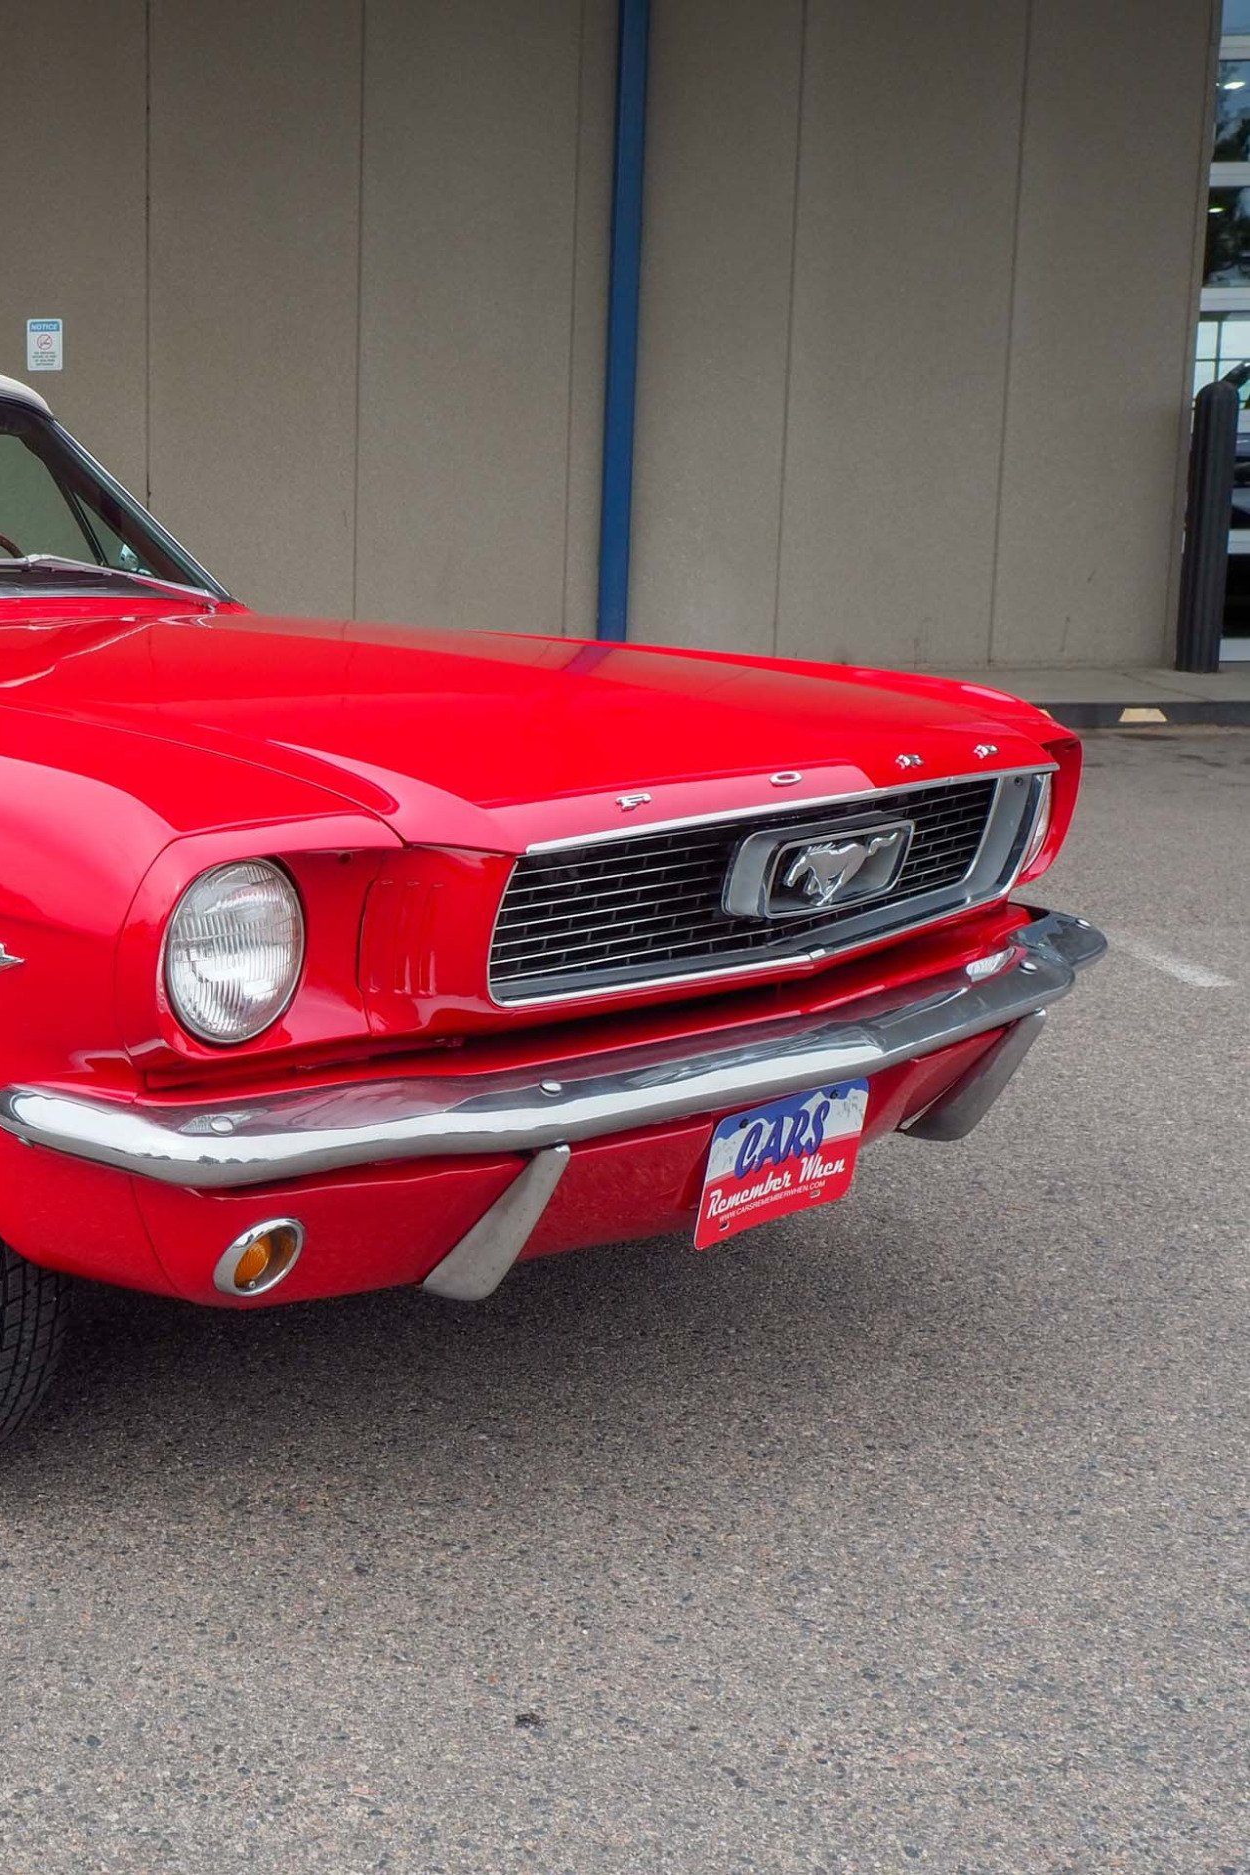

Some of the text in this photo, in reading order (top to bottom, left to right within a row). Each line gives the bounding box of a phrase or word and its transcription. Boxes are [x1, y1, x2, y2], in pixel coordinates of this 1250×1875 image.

[734, 1100, 831, 1179] CARS
[707, 1153, 845, 1220] Remember When
[718, 1180, 826, 1223] WWW.CARSREMEMBERWHEN.COM
